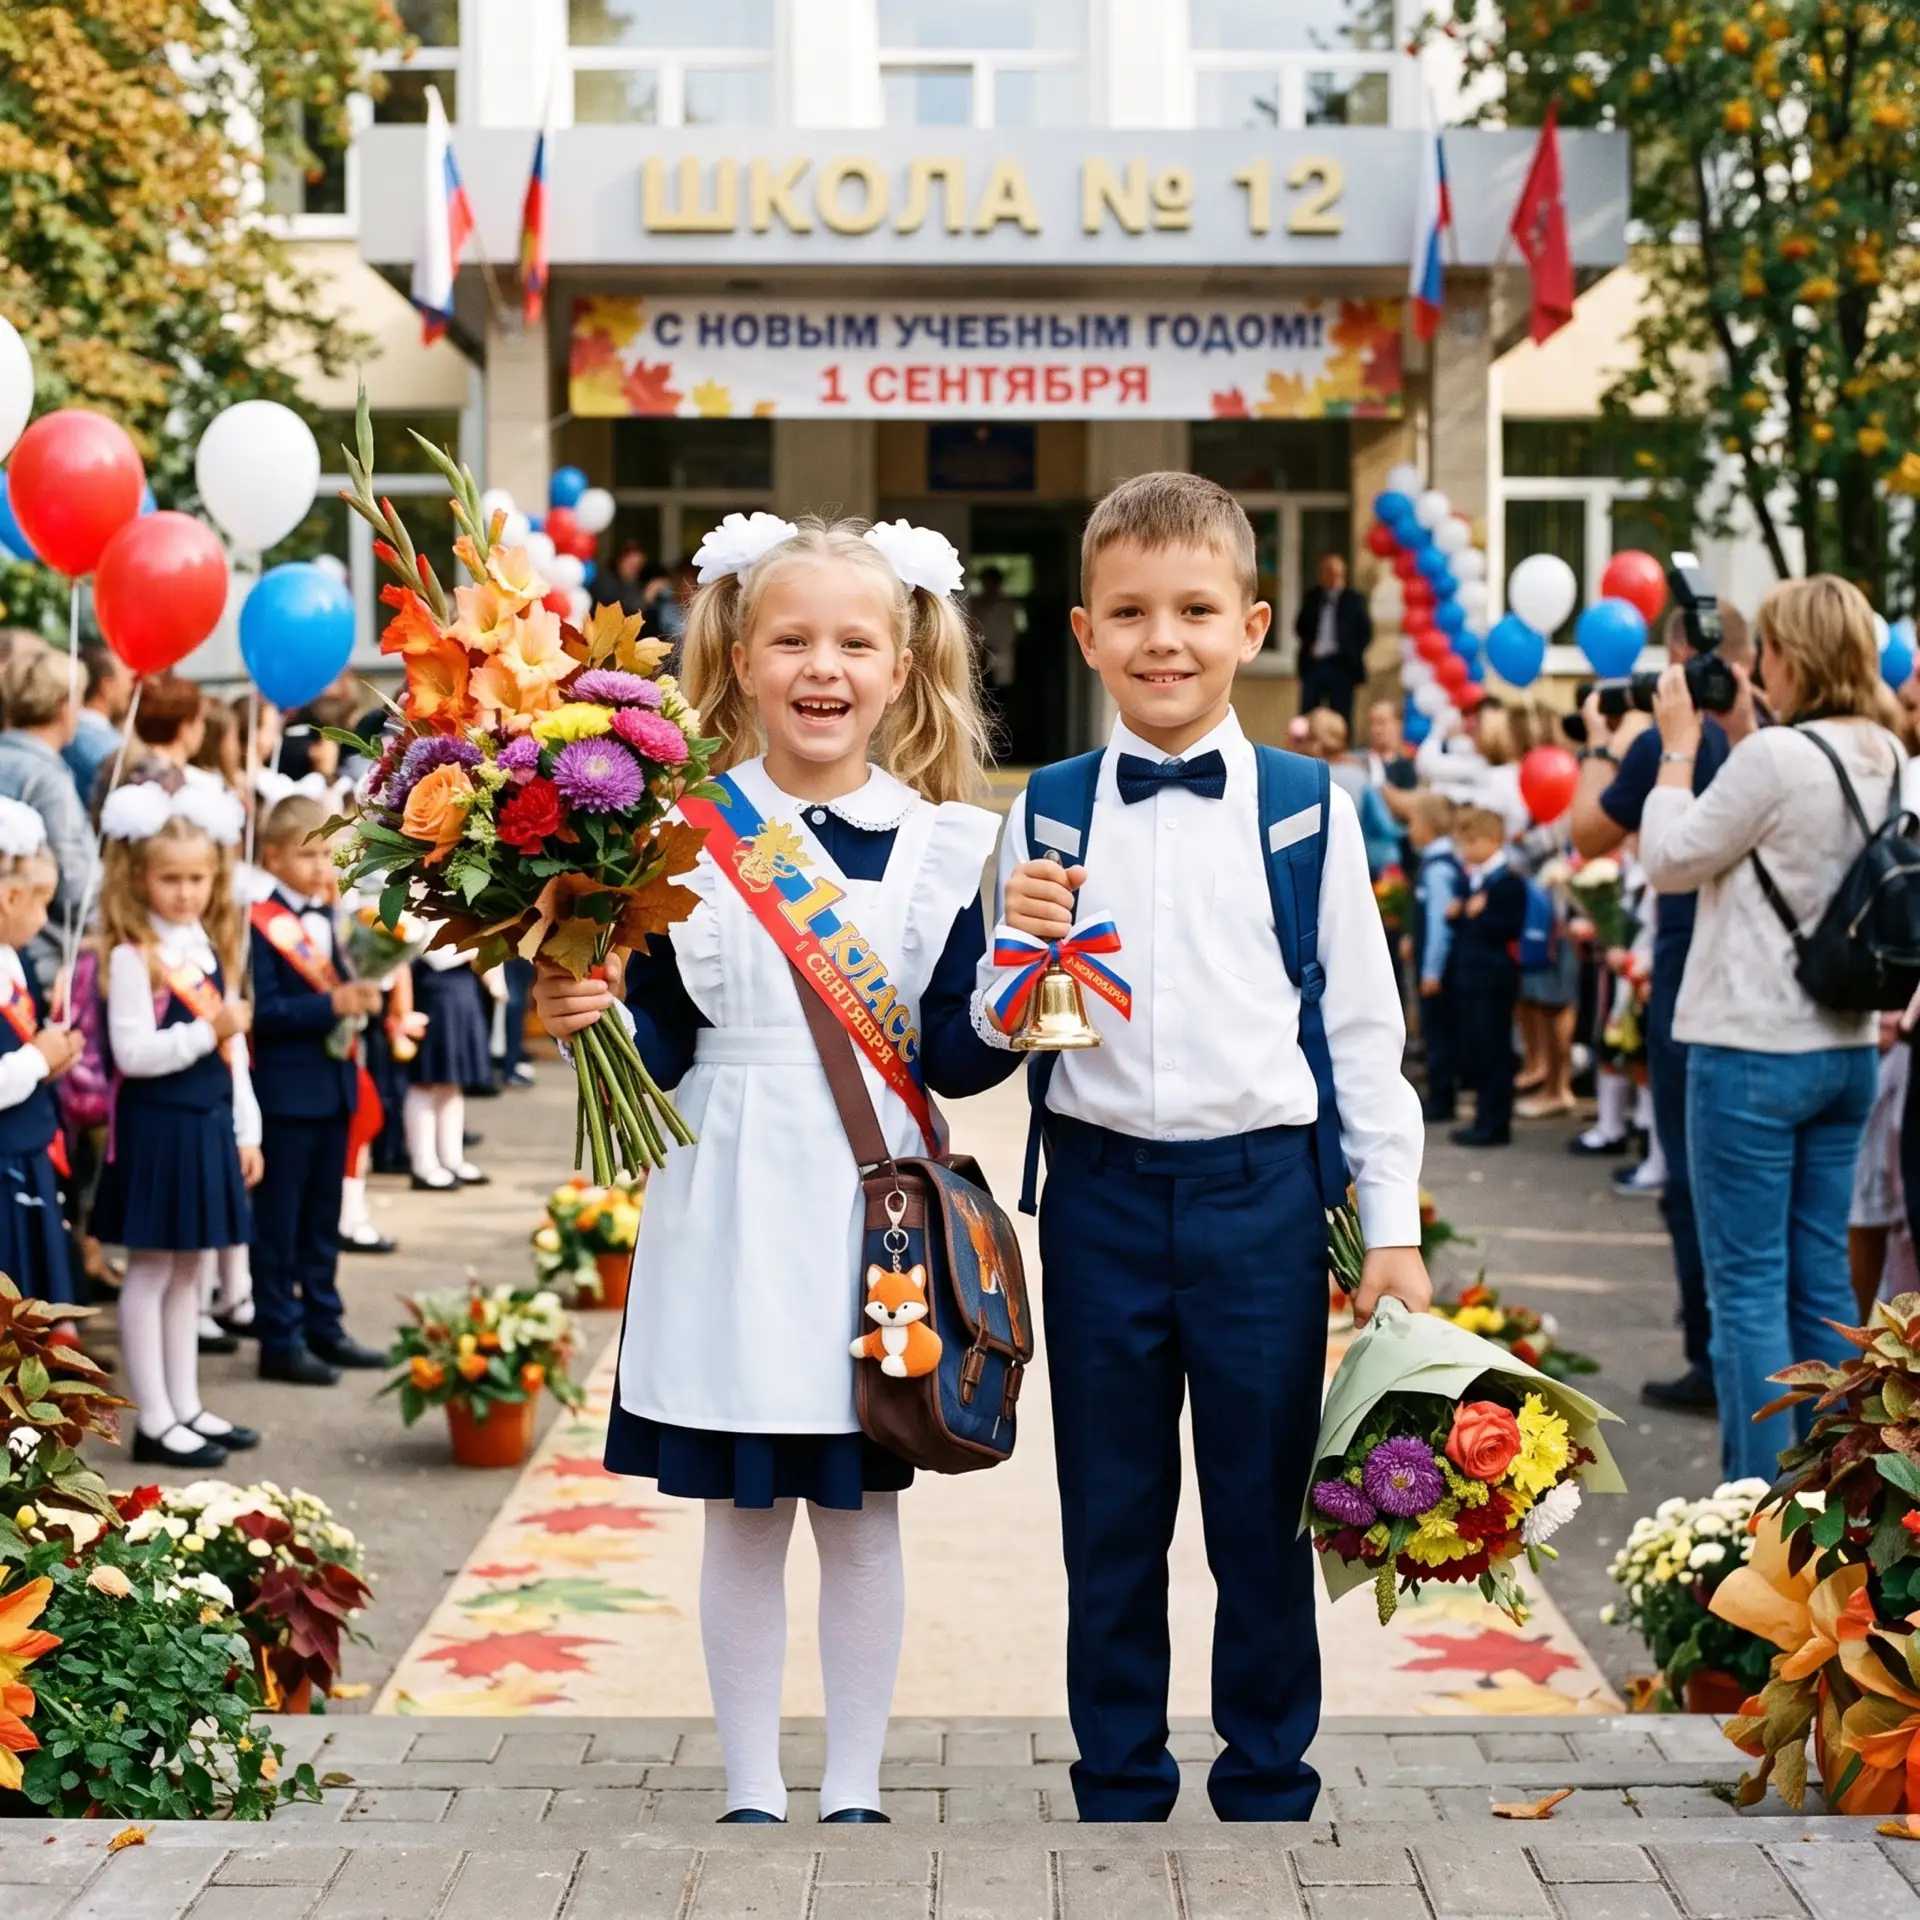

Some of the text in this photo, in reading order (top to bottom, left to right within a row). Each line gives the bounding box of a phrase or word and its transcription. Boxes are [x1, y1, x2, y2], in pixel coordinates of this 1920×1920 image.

[642, 155, 1345, 236] ШКОЛА № 12
[654, 312, 1324, 355] С НОВЫМ УЧЕБНЫМ ГОДОМ!
[820, 364, 1150, 405] 1 СЕНТЯБРЯ
[777, 876, 921, 1062] 1 КЛАСС
[806, 953, 895, 1065] СЕНТЯБРЯ
